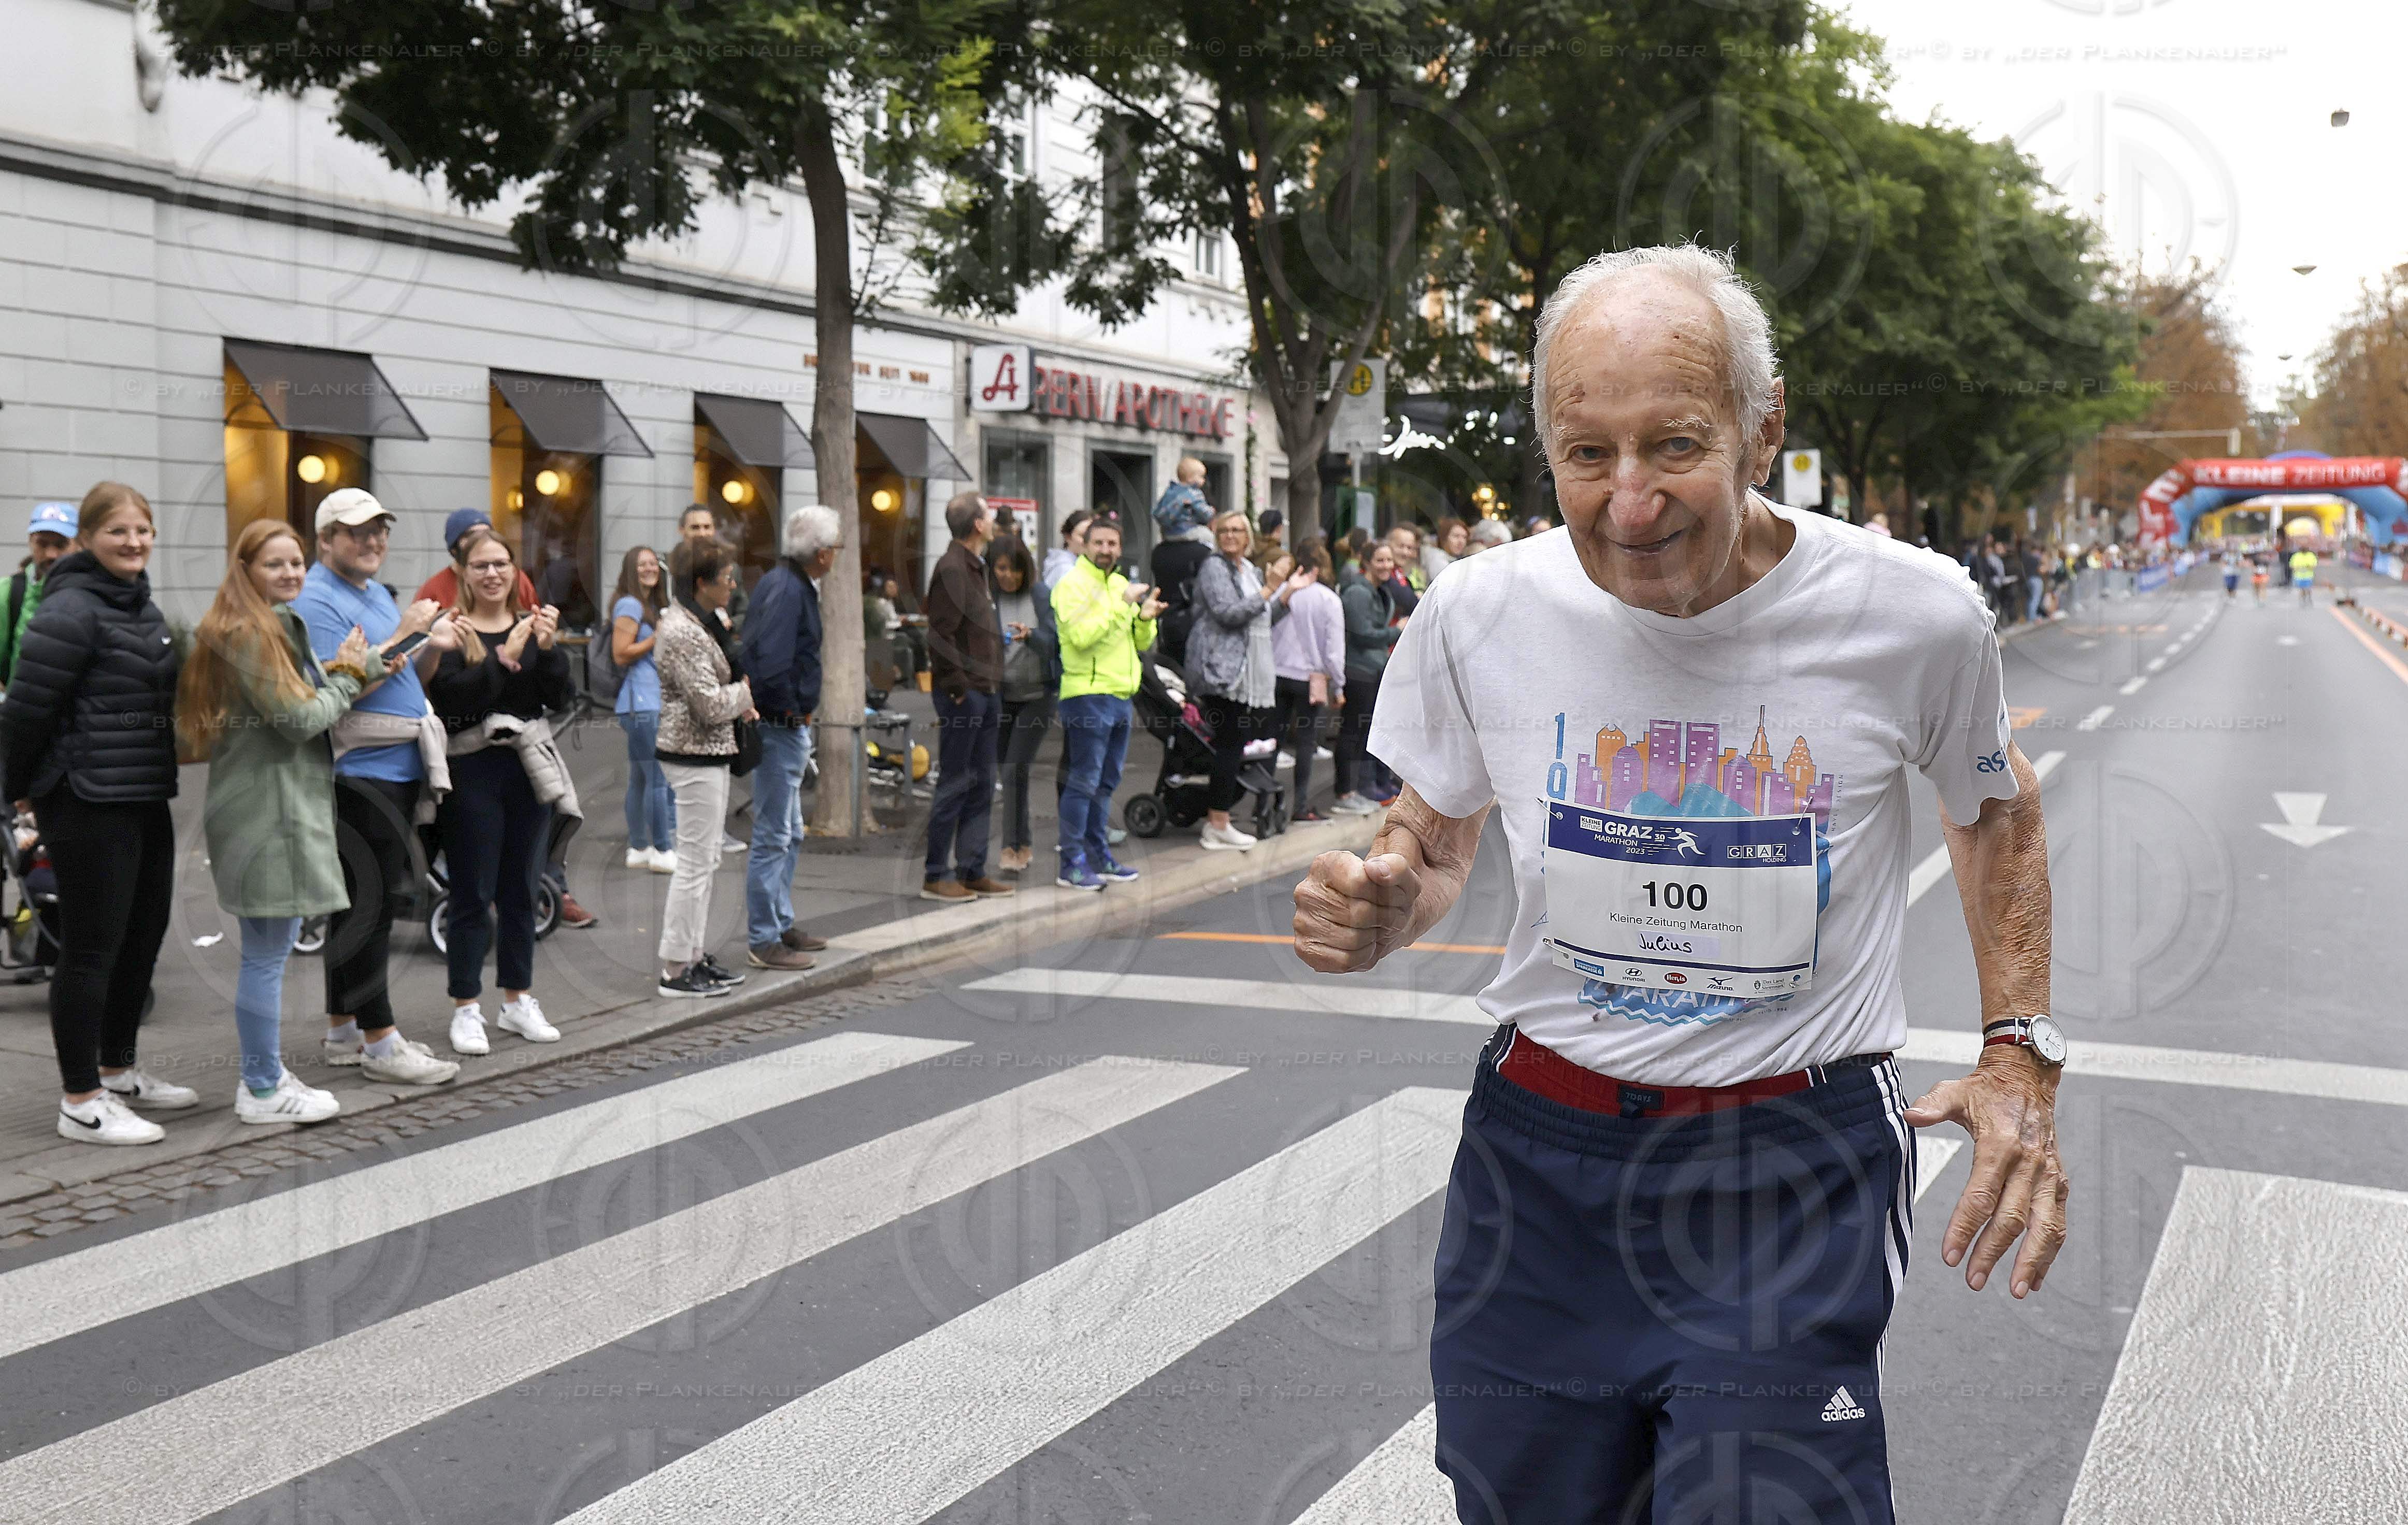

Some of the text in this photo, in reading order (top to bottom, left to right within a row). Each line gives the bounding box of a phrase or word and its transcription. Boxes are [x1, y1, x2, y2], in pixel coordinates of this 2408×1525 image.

[1115, 380, 1235, 437] APOTHEKE
[1581, 817, 1601, 826] KLEINE
[1581, 822, 1601, 831] ZEITUNG
[1604, 822, 1654, 839] GRAZ
[1594, 834, 1638, 846] MARATHON
[1729, 845, 1785, 858] GRAZ
[1642, 881, 1708, 911] 100
[1610, 912, 1743, 932] Kleine Zeitung Marathon
[1639, 933, 1693, 954] Julius
[1821, 1407, 1865, 1422] adidas
